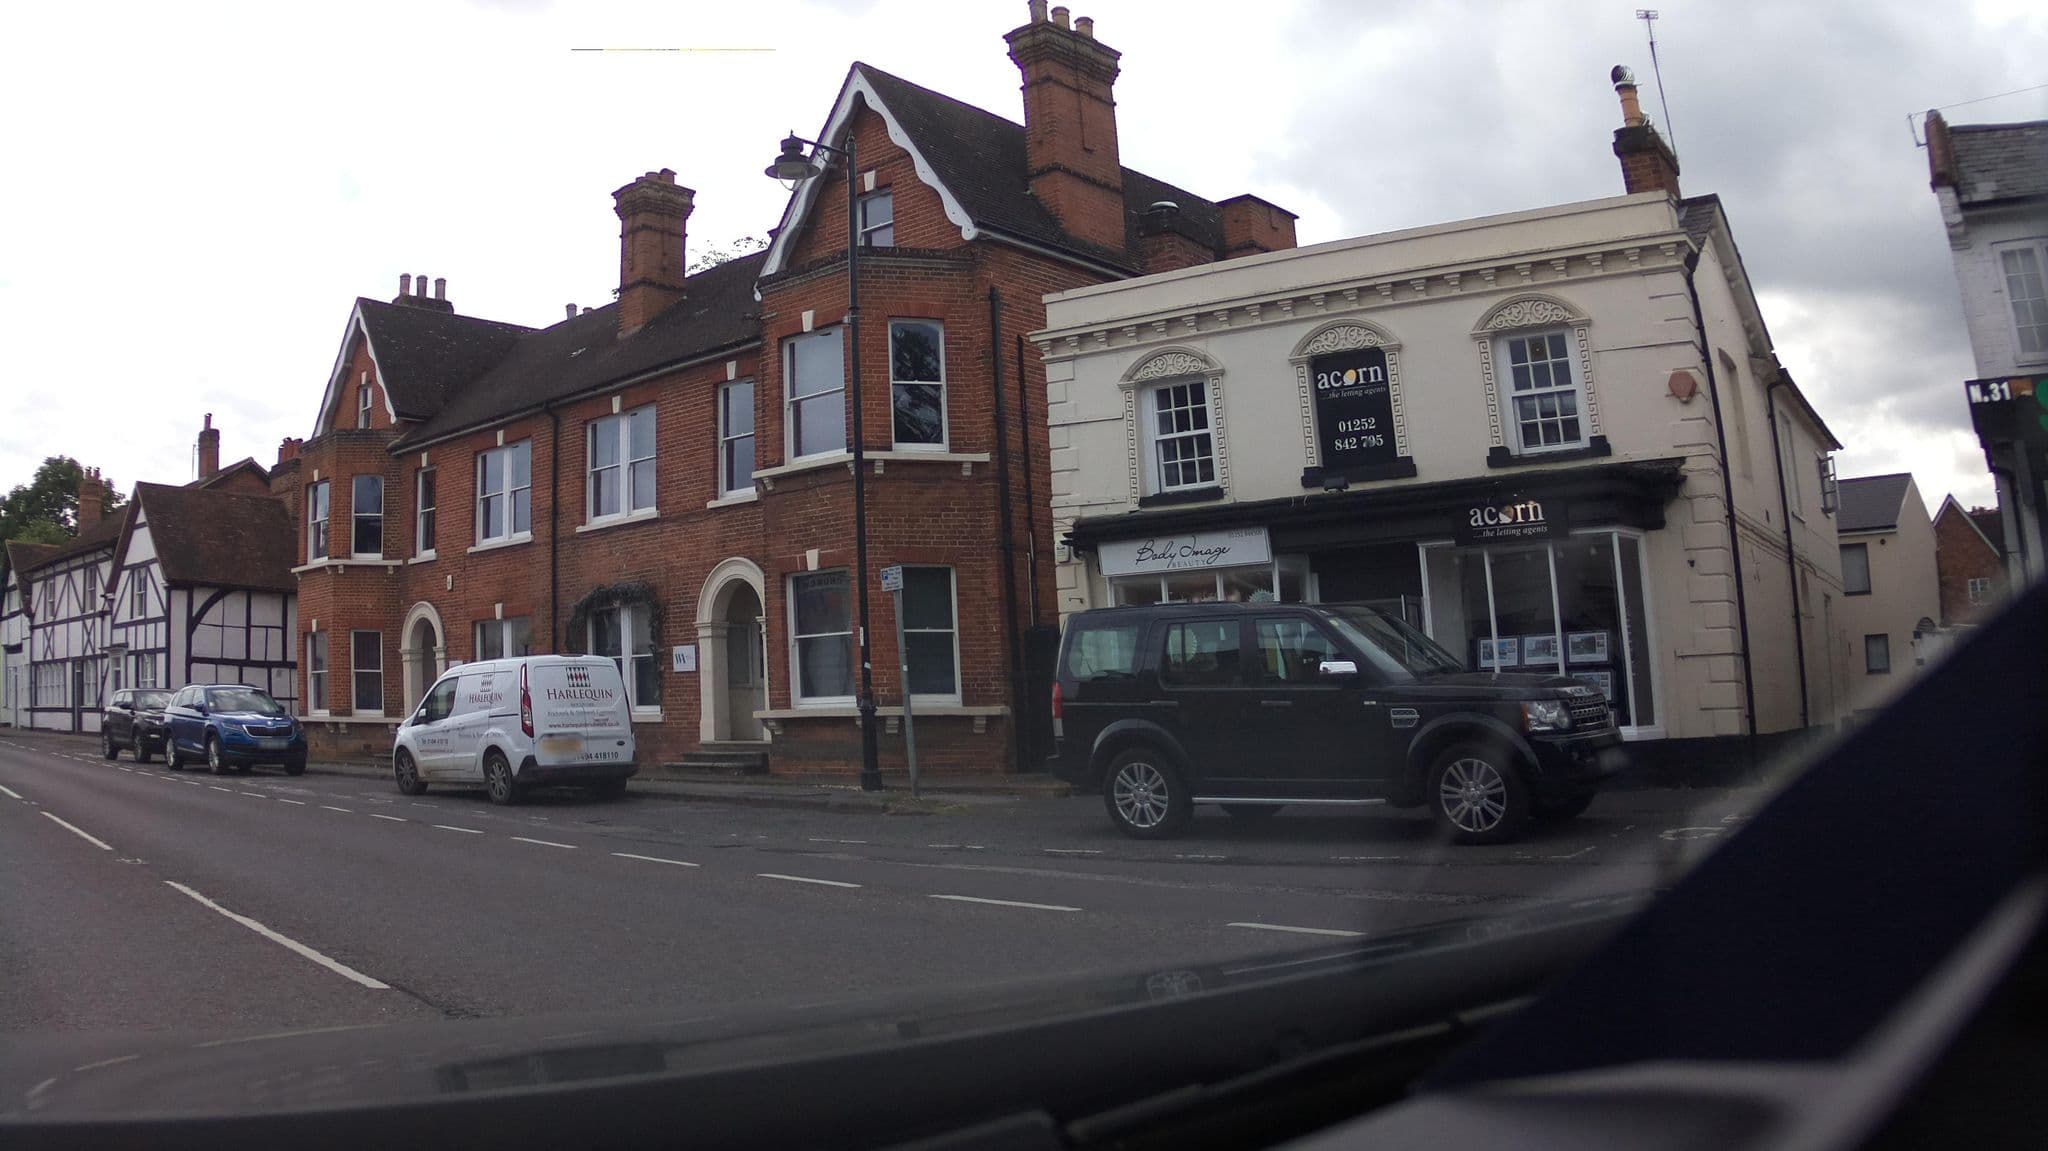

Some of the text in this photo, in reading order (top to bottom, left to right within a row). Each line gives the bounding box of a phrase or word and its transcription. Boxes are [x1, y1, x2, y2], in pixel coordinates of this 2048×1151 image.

[1317, 366, 1384, 389] acorn
[1341, 388, 1363, 397] letting
[1364, 386, 1386, 395] agents
[1339, 417, 1376, 432] 01252
[1334, 434, 1384, 451] 842 795
[1469, 501, 1544, 526] acorn
[1496, 527, 1521, 536] letting
[1522, 525, 1548, 535] agents
[1135, 535, 1231, 569] Body Image
[547, 688, 613, 701] HARLEQUIN
